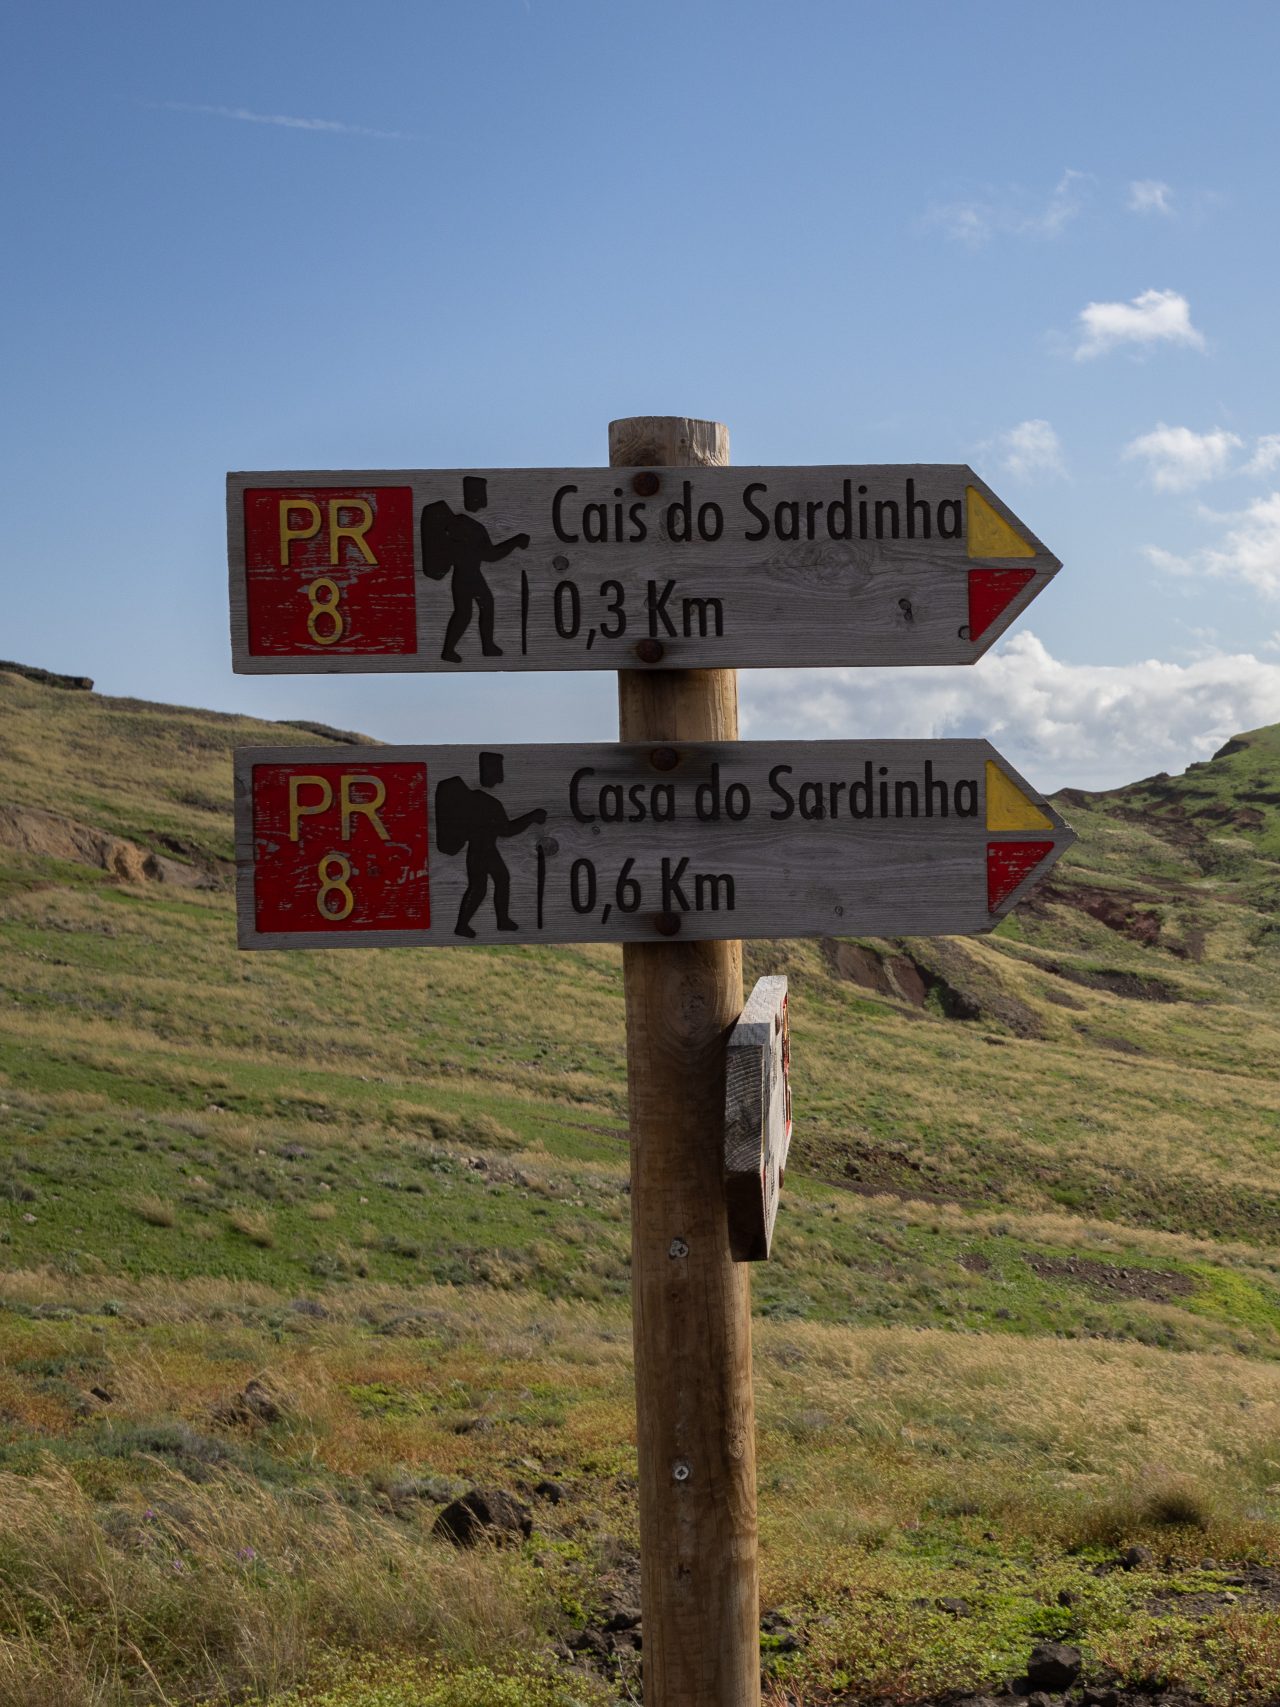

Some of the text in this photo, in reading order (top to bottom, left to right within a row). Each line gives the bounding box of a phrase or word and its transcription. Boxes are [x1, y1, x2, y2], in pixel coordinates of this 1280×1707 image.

[279, 499, 378, 566] PR
[552, 478, 963, 544] Cais do Sardinha
[306, 577, 344, 645] 8
[553, 579, 724, 650] 0,3 Km
[288, 774, 391, 842] PR
[569, 759, 978, 825] Casa do Sardinha
[316, 853, 354, 921] 8
[570, 856, 736, 925] 0,6 Km
